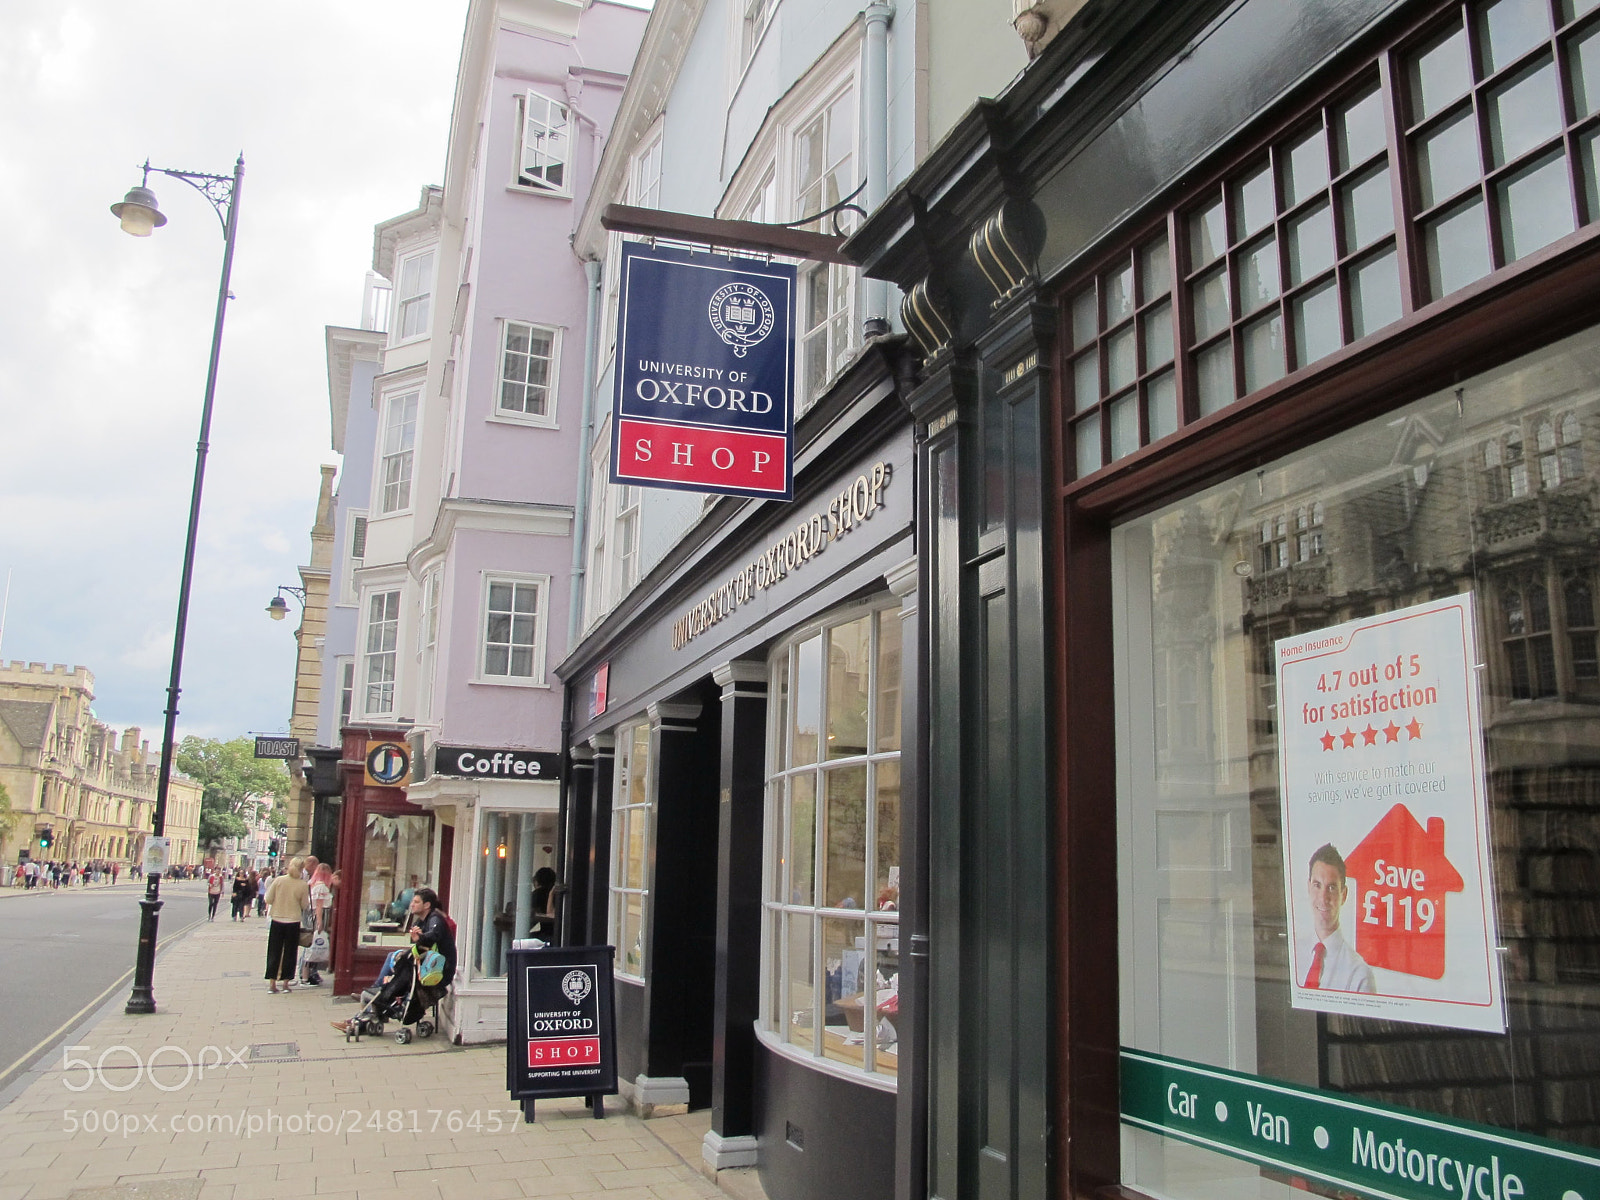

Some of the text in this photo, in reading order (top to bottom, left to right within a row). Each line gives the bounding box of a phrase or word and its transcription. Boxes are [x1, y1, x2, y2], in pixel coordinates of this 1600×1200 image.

[711, 285, 772, 337] UNIVERSITY OF OXFORD
[639, 359, 748, 383] UNIVERSITY OF
[636, 378, 773, 414] OXFORD
[634, 438, 771, 473] SHOP
[671, 461, 886, 651] UNIVERSITY OF OXFORD SHOP
[1280, 634, 1344, 658] Home Insurance
[1317, 654, 1421, 693] 4.7 out of 5
[1302, 684, 1437, 725] for satisfaction
[257, 740, 298, 756] TOAST
[457, 752, 542, 776] Coffee
[1314, 760, 1436, 785] With service to match our
[1308, 776, 1446, 805] savings, we've got it covered
[1374, 859, 1425, 891] Save
[534, 1011, 571, 1019] UNIVERSITY
[534, 1018, 593, 1031] OXFORD
[535, 1045, 594, 1059] SHOP
[528, 1070, 560, 1078] SUPPORTING
[1166, 1081, 1525, 1200] Car Van Motorcycle
